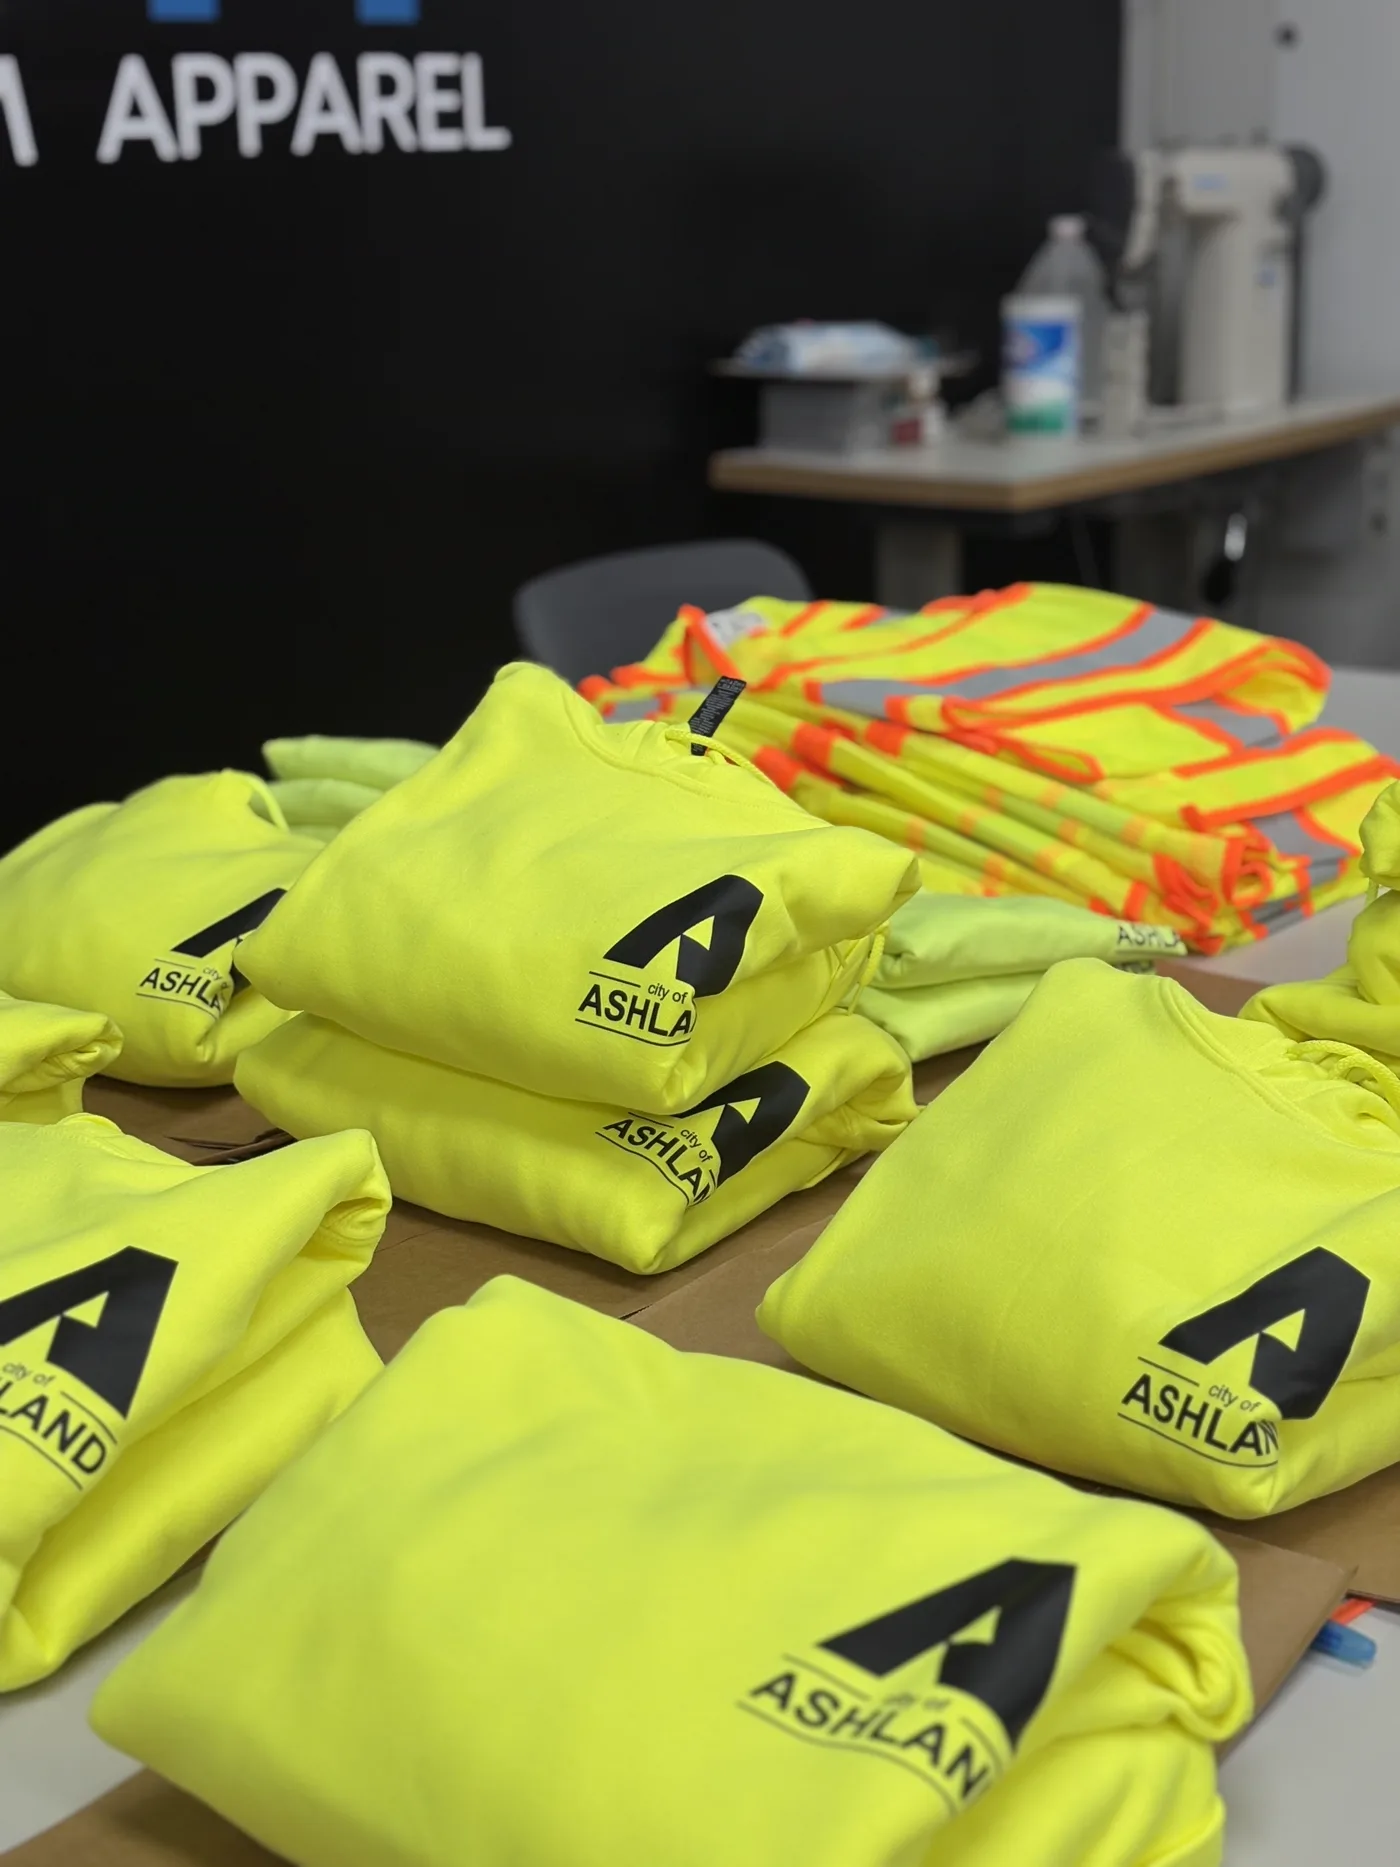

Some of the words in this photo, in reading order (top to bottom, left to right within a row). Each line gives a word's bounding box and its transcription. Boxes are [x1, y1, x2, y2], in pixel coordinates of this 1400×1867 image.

[96, 51, 513, 164] APPAREL
[647, 982, 670, 1001] city
[671, 991, 689, 1005] of
[680, 1129, 702, 1149] city
[698, 1149, 714, 1163] of
[1208, 1382, 1239, 1408] city
[1239, 1399, 1262, 1412] of
[749, 1670, 994, 1801] ASHLAN
